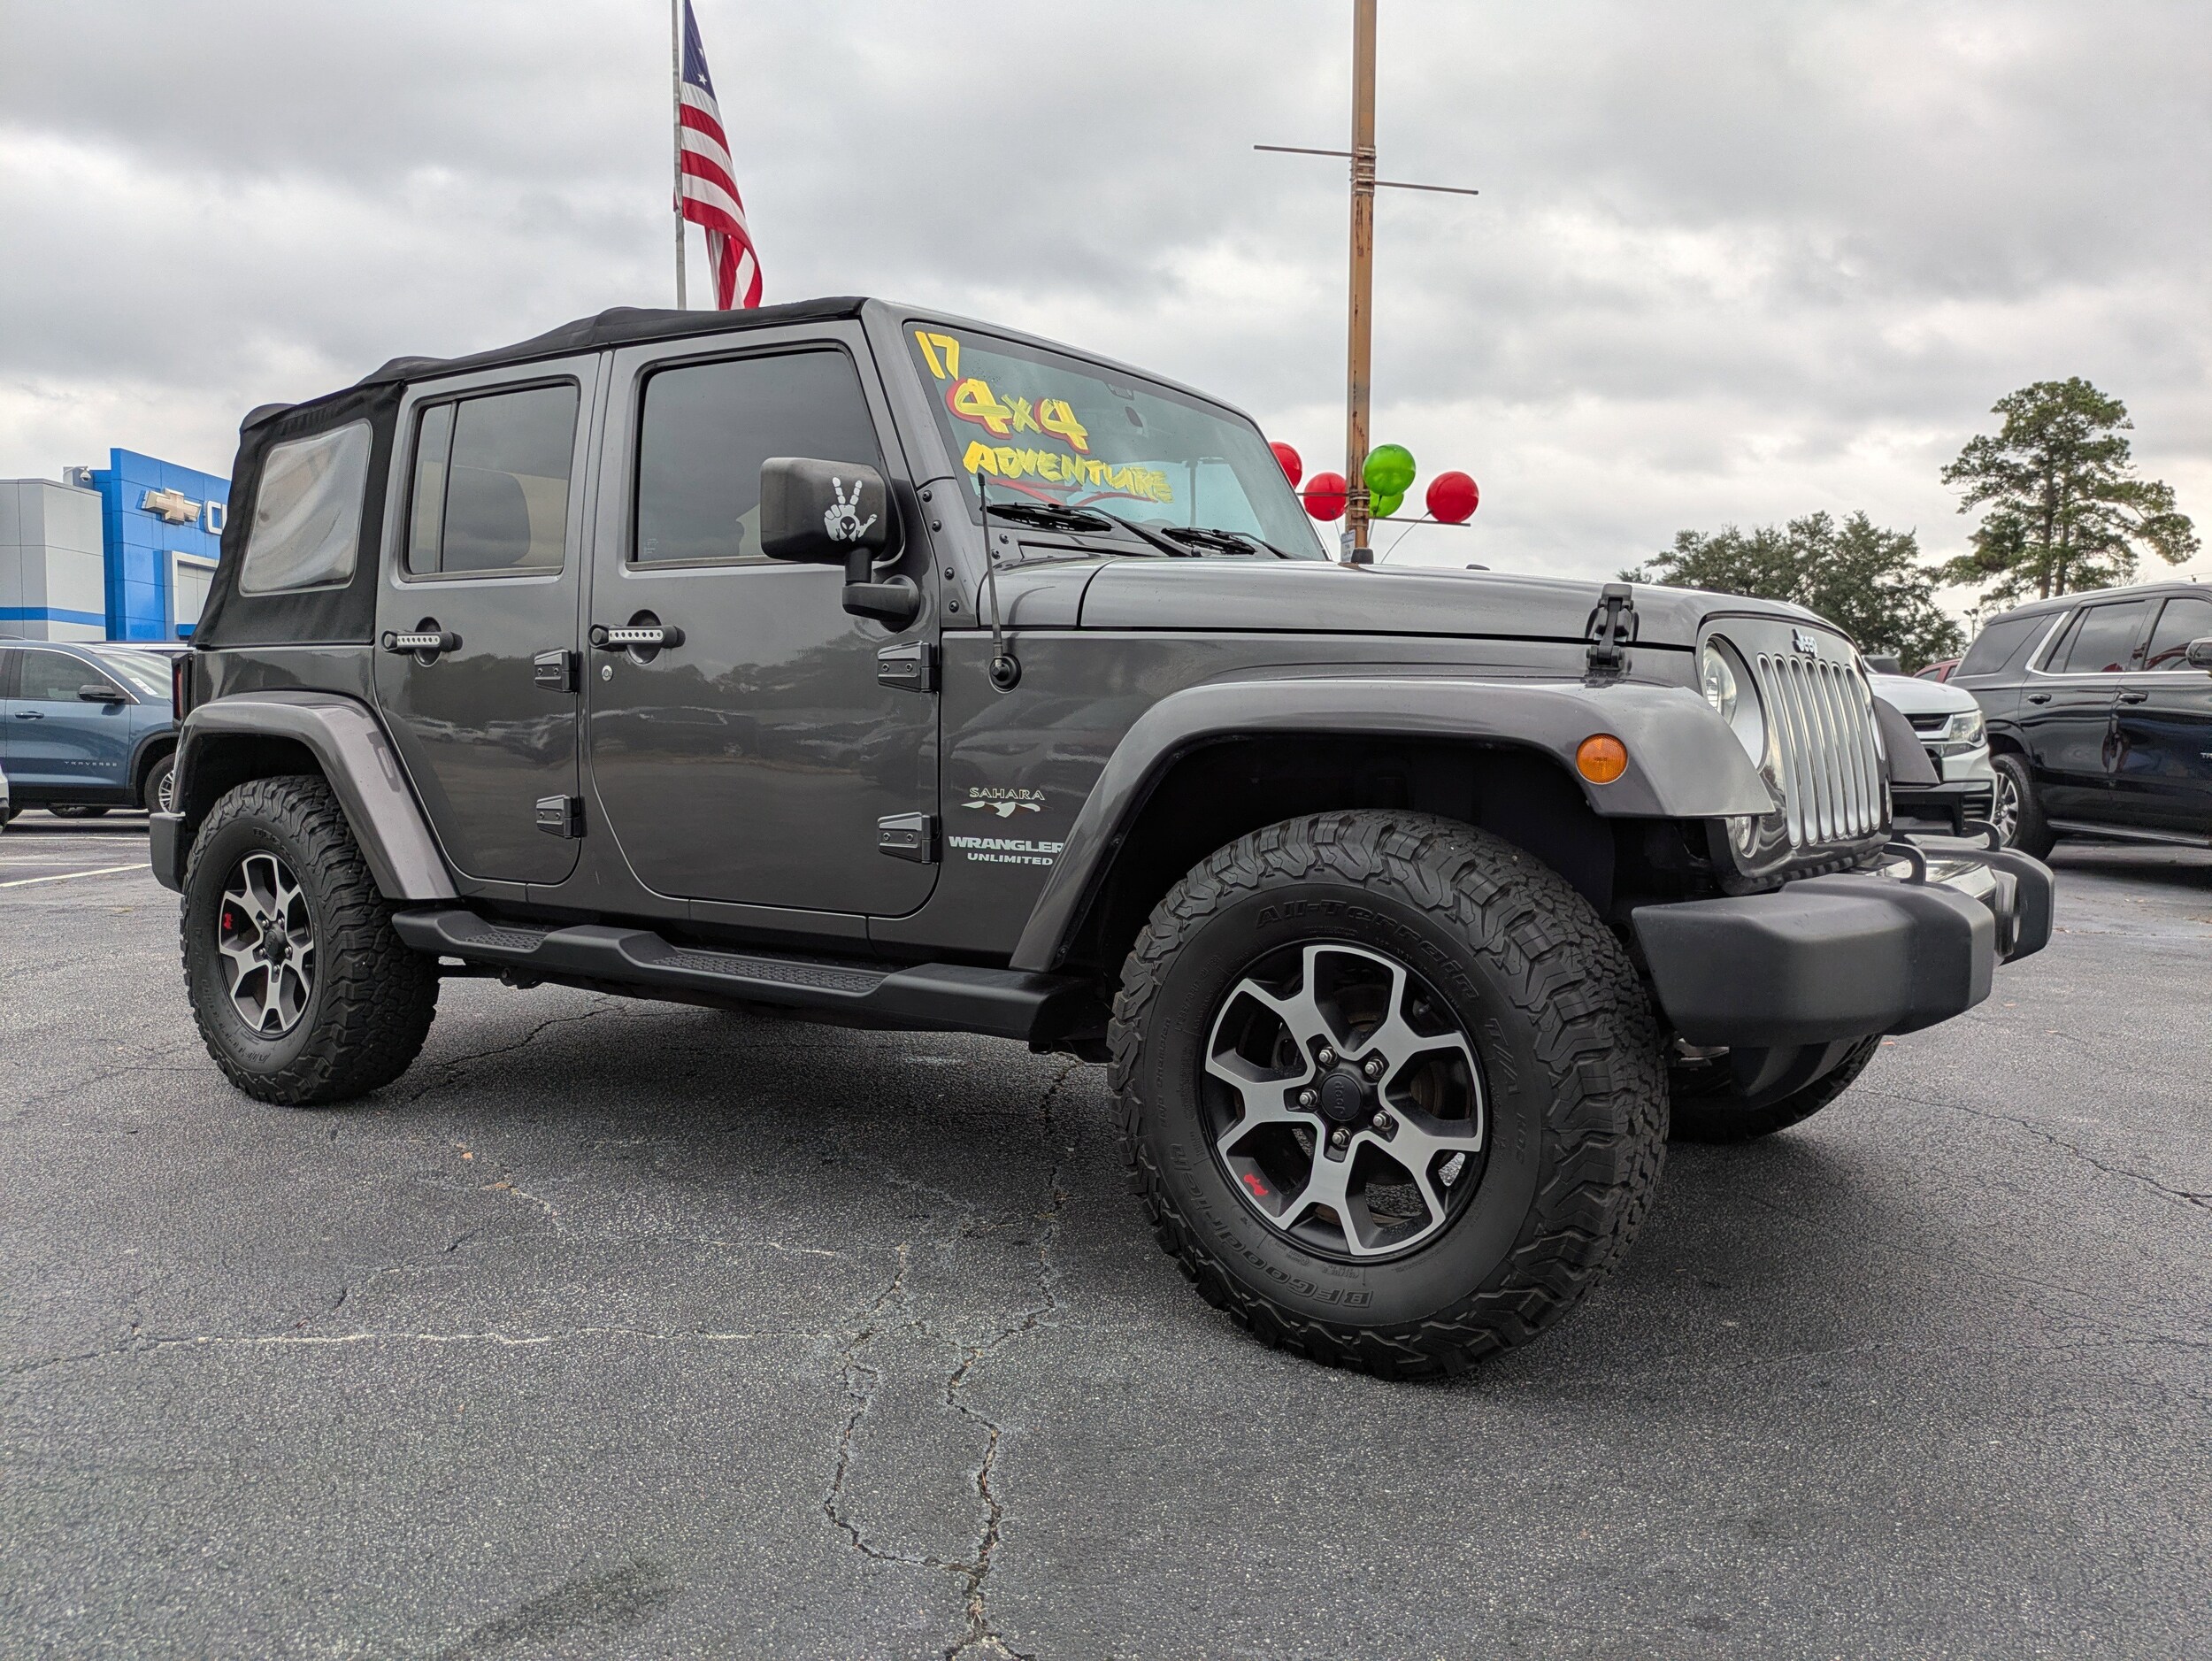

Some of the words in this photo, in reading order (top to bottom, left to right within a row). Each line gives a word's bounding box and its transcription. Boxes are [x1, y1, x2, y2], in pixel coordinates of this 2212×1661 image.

[915, 330, 959, 381] 17
[963, 440, 1174, 504] ADVENTURE
[1792, 628, 1818, 658] Jeep
[969, 787, 1045, 801] SAHARA
[949, 835, 1064, 854] WRANGLER
[967, 852, 1053, 866] UNLIMITED
[1170, 1143, 1375, 1309] BFGoodrich
